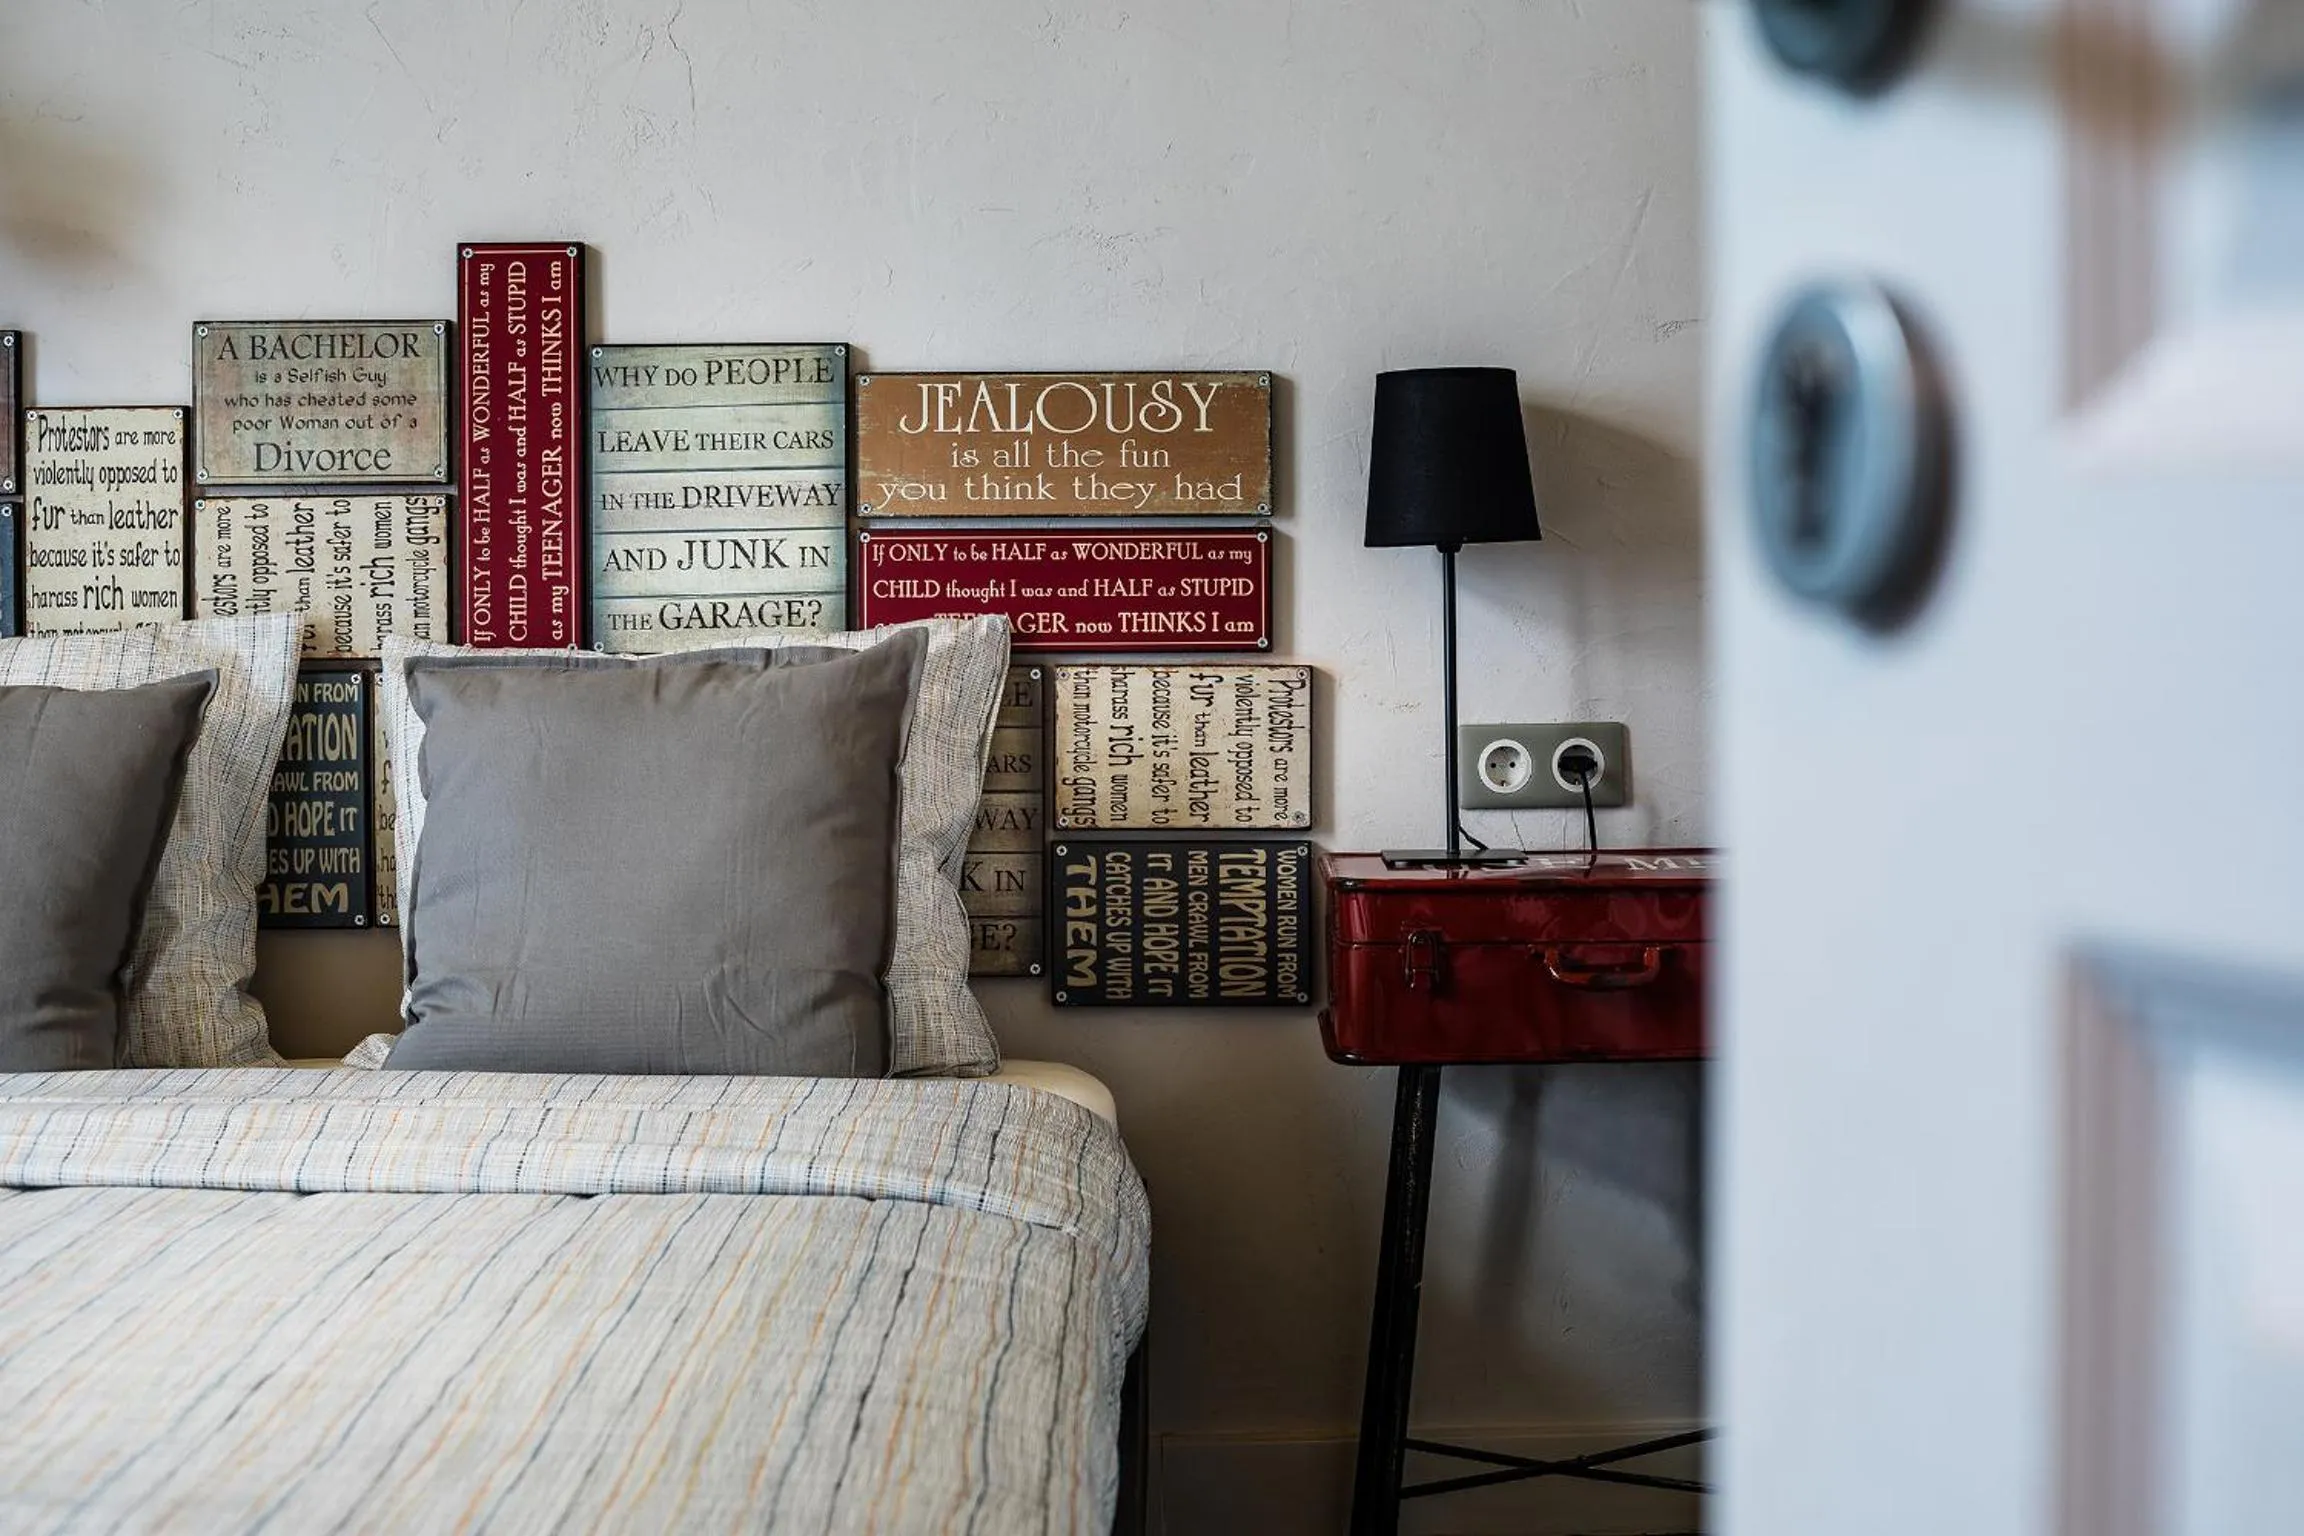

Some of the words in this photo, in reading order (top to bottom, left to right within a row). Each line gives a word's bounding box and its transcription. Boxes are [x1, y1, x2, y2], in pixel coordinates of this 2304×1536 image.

[480, 263, 495, 286] my
[550, 261, 561, 290] am
[480, 290, 489, 308] as
[508, 261, 526, 335] STUPID
[217, 334, 239, 360] A
[250, 332, 420, 360] BACHELOR
[517, 339, 526, 357] as
[542, 308, 562, 397] THINKS
[255, 370, 266, 383] is
[274, 373, 282, 383] a
[288, 369, 346, 383] Selfish
[353, 367, 387, 387] Guy
[473, 311, 490, 442] WONDERFUL
[593, 365, 659, 388] WHY
[665, 368, 697, 386] DO
[704, 357, 834, 386] PEOPLE
[224, 395, 259, 407] who
[266, 394, 291, 407] has
[298, 393, 366, 407] cheated
[373, 395, 417, 407] some
[508, 362, 526, 421] HALF
[899, 379, 1223, 434] JEALOUSY
[38, 414, 109, 452] Protestors
[115, 431, 138, 445] are
[144, 430, 176, 445] more
[232, 420, 272, 434] poor
[280, 416, 338, 430] Woman
[345, 418, 373, 429] out
[381, 416, 402, 429] of
[409, 418, 417, 429] a
[551, 402, 562, 440] now
[253, 441, 391, 472] Divorce
[481, 447, 490, 464] as
[509, 426, 526, 457] and
[598, 430, 690, 453] LEAVE
[696, 432, 767, 451] THEIR
[773, 430, 834, 449] CARS
[951, 442, 979, 468] is
[994, 442, 1030, 468] all
[1046, 442, 1105, 468] the
[1120, 440, 1170, 468] fun
[34, 459, 94, 492] violently
[100, 458, 157, 492] opposed
[162, 458, 177, 483] to
[517, 462, 527, 493] was
[878, 481, 946, 509] you
[964, 474, 1055, 501] think
[1073, 474, 1156, 507] they
[1175, 473, 1243, 501] had
[244, 504, 269, 519] to
[325, 500, 351, 515] to
[473, 468, 491, 523] HALF
[601, 494, 624, 510] IN
[629, 492, 675, 509] THE
[682, 484, 841, 508] DRIVEWAY
[32, 496, 65, 531] fur
[70, 509, 104, 525] than
[109, 499, 178, 531] leather
[217, 506, 231, 540] more
[375, 502, 392, 549] women
[406, 497, 440, 545] gangs
[541, 446, 563, 581] TEENAGER
[286, 502, 315, 573] leather
[327, 522, 352, 561] safer
[473, 527, 491, 545] be
[509, 510, 532, 569] thought
[30, 542, 87, 567] because
[93, 540, 114, 567] it's
[120, 542, 159, 567] safer
[164, 540, 180, 566] to
[218, 544, 231, 567] are
[244, 524, 277, 584] opposed
[477, 547, 491, 561] to
[602, 548, 666, 572] AND
[677, 538, 790, 570] JUNK
[799, 546, 831, 567] IN
[872, 544, 885, 567] If
[889, 543, 948, 561] ONLY
[954, 547, 966, 561] to
[971, 544, 987, 561] be
[992, 542, 1047, 560] HALF
[1051, 551, 1067, 560] as
[1072, 542, 1203, 560] WONDERFUL
[1208, 550, 1224, 559] as
[1230, 550, 1252, 564] my
[32, 585, 78, 609] harass
[83, 575, 124, 610] rich
[132, 590, 177, 608] women
[327, 567, 352, 589] it's
[360, 556, 395, 598] rich
[406, 549, 437, 618] motorcycle
[873, 579, 940, 598] CHILD
[946, 579, 1005, 603] thought
[1010, 579, 1016, 597] I
[1022, 588, 1052, 597] was
[1058, 578, 1089, 597] and
[1093, 578, 1153, 596] HALF
[1158, 586, 1176, 596] as
[1181, 578, 1254, 596] STUPID
[202, 574, 238, 616] estors
[295, 578, 310, 612] than
[473, 566, 491, 625] ONLY
[510, 573, 527, 641] CHILD
[552, 585, 569, 614] my
[552, 620, 563, 640] as
[608, 614, 652, 631] THE
[659, 600, 822, 630] GARAGE?
[1075, 622, 1113, 633] now
[1118, 612, 1206, 633] THINKS
[1212, 612, 1219, 632] I
[1225, 621, 1254, 632] am
[474, 629, 496, 641] If
[314, 683, 358, 702] FROM
[1073, 669, 1098, 699] than
[1111, 672, 1136, 719] harass
[1152, 671, 1179, 729] because
[1189, 673, 1224, 707] fur
[1228, 674, 1261, 737] violently
[1268, 679, 1306, 752] Protestors
[286, 713, 357, 761] ATION
[1067, 703, 1098, 772] motorcycle
[1109, 725, 1144, 766] rich
[1152, 735, 1179, 758] it's
[1195, 712, 1211, 747] than
[987, 754, 1032, 773] ARS
[1227, 742, 1261, 801] opposed
[1275, 758, 1288, 782] are
[275, 772, 308, 791] AWL
[313, 771, 358, 791] FROM
[1110, 774, 1128, 821] women
[1152, 763, 1177, 802] safer
[1189, 751, 1219, 822] leather
[1062, 776, 1096, 825] gangs
[1152, 808, 1178, 824] to
[1235, 806, 1260, 822] to
[1274, 787, 1288, 821] more
[285, 801, 335, 837] HOPE
[341, 807, 358, 831] IT
[293, 848, 315, 874] UP
[319, 848, 360, 873] WITH
[1147, 854, 1172, 871] IT
[1188, 850, 1208, 886] MEN
[994, 870, 1027, 891] IN
[1106, 852, 1132, 927] CATCHES
[1277, 850, 1297, 910] WOMEN
[260, 883, 349, 913] HEM
[1143, 878, 1179, 917] AND
[1066, 855, 1097, 986] THEM
[1188, 891, 1208, 948] CRAWL
[1219, 849, 1268, 996] TEMPTATION
[1277, 915, 1297, 948] RUN
[1106, 932, 1132, 953] UP
[1143, 924, 1179, 974] HOPE
[1106, 958, 1132, 999] WITH
[1148, 979, 1173, 997] IT
[1188, 952, 1208, 998] FROM
[1277, 953, 1297, 998] FROM
